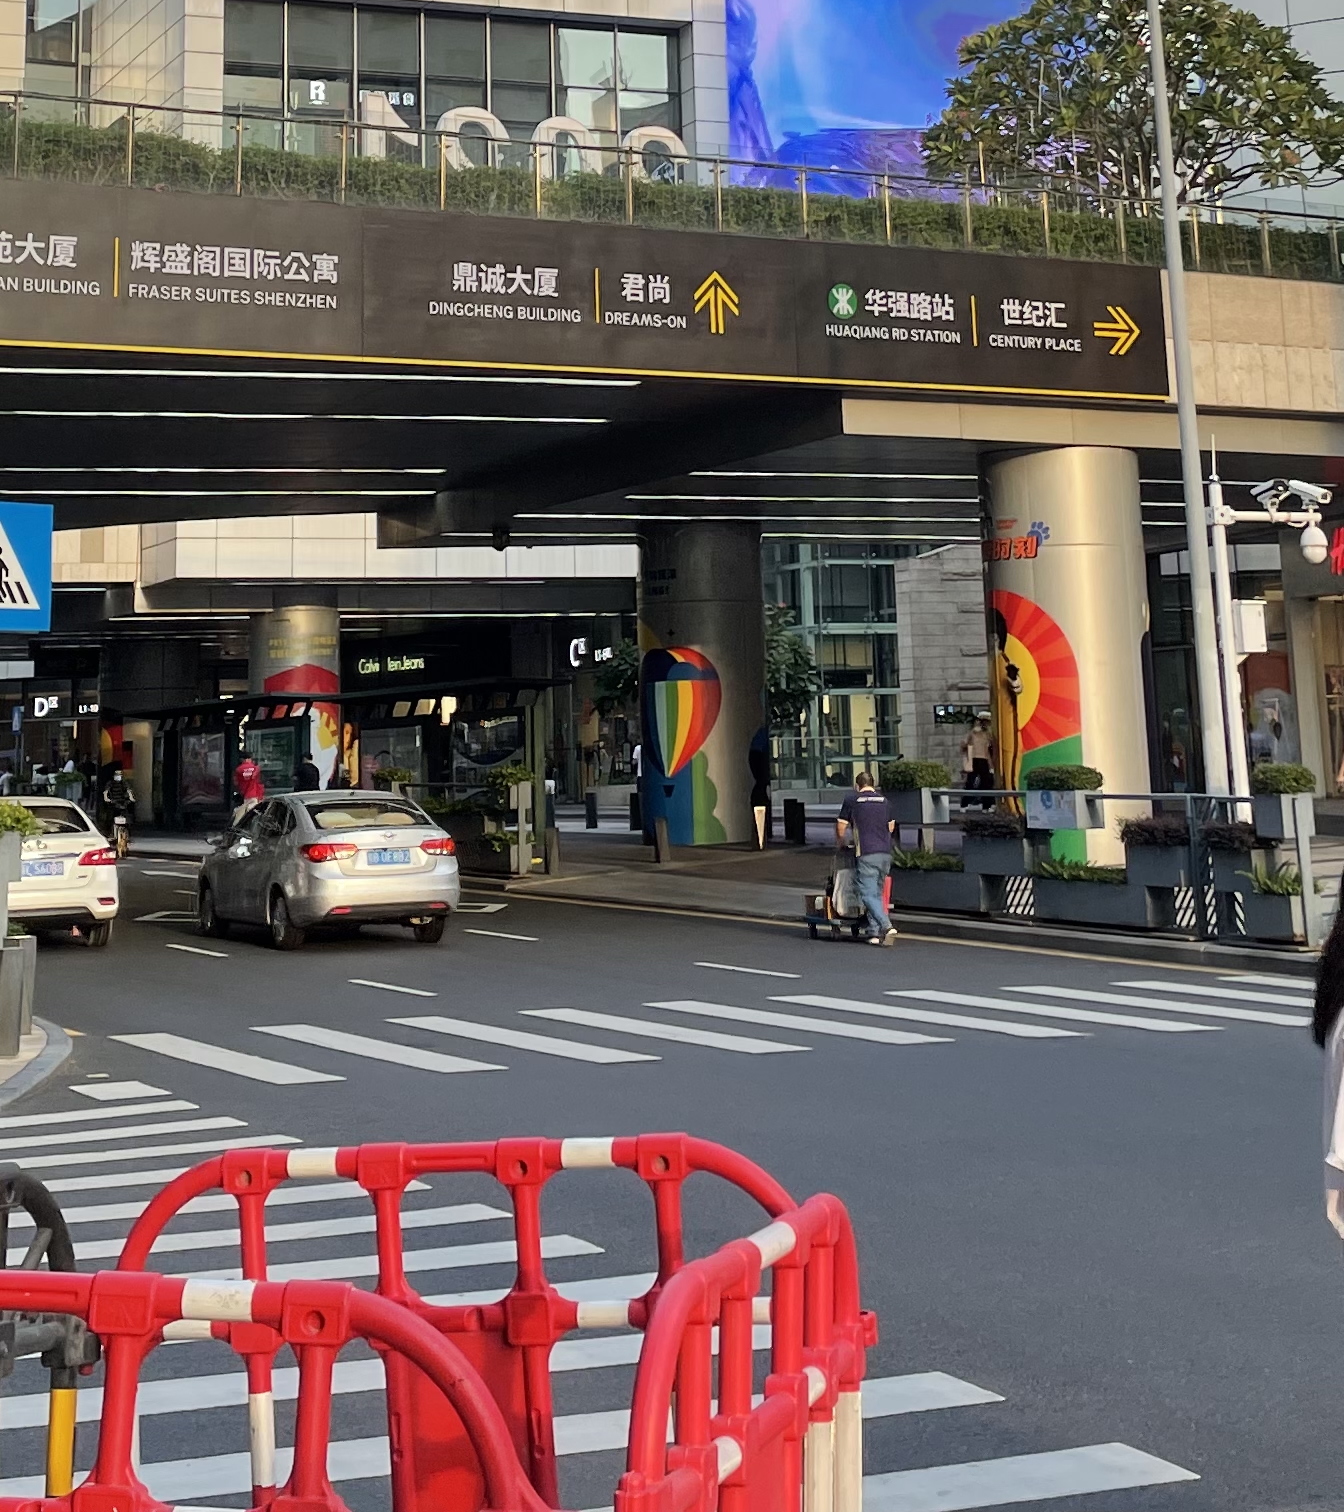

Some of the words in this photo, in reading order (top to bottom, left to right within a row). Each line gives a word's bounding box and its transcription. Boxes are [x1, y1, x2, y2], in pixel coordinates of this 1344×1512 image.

[130, 240, 340, 285] 辉盛阁国际公寓
[23, 277, 101, 297] BUILDING
[452, 261, 559, 298] 鼎诚大厦
[620, 272, 671, 305] 君尚
[128, 283, 192, 302] FRASER
[195, 287, 251, 305] SUITES
[254, 290, 338, 310] SHENZHEN
[864, 288, 955, 322] 华强路站
[429, 300, 514, 320] DINGCHENG
[517, 306, 582, 324] BUILDING
[604, 311, 688, 330] DREAMS-ON
[1000, 297, 1068, 329] 世纪汇
[825, 323, 890, 341] HUAQIANG
[892, 327, 908, 342] RD
[910, 329, 961, 344] STATION
[988, 334, 1043, 350] CENTURY
[1045, 337, 1083, 353] PLACE
